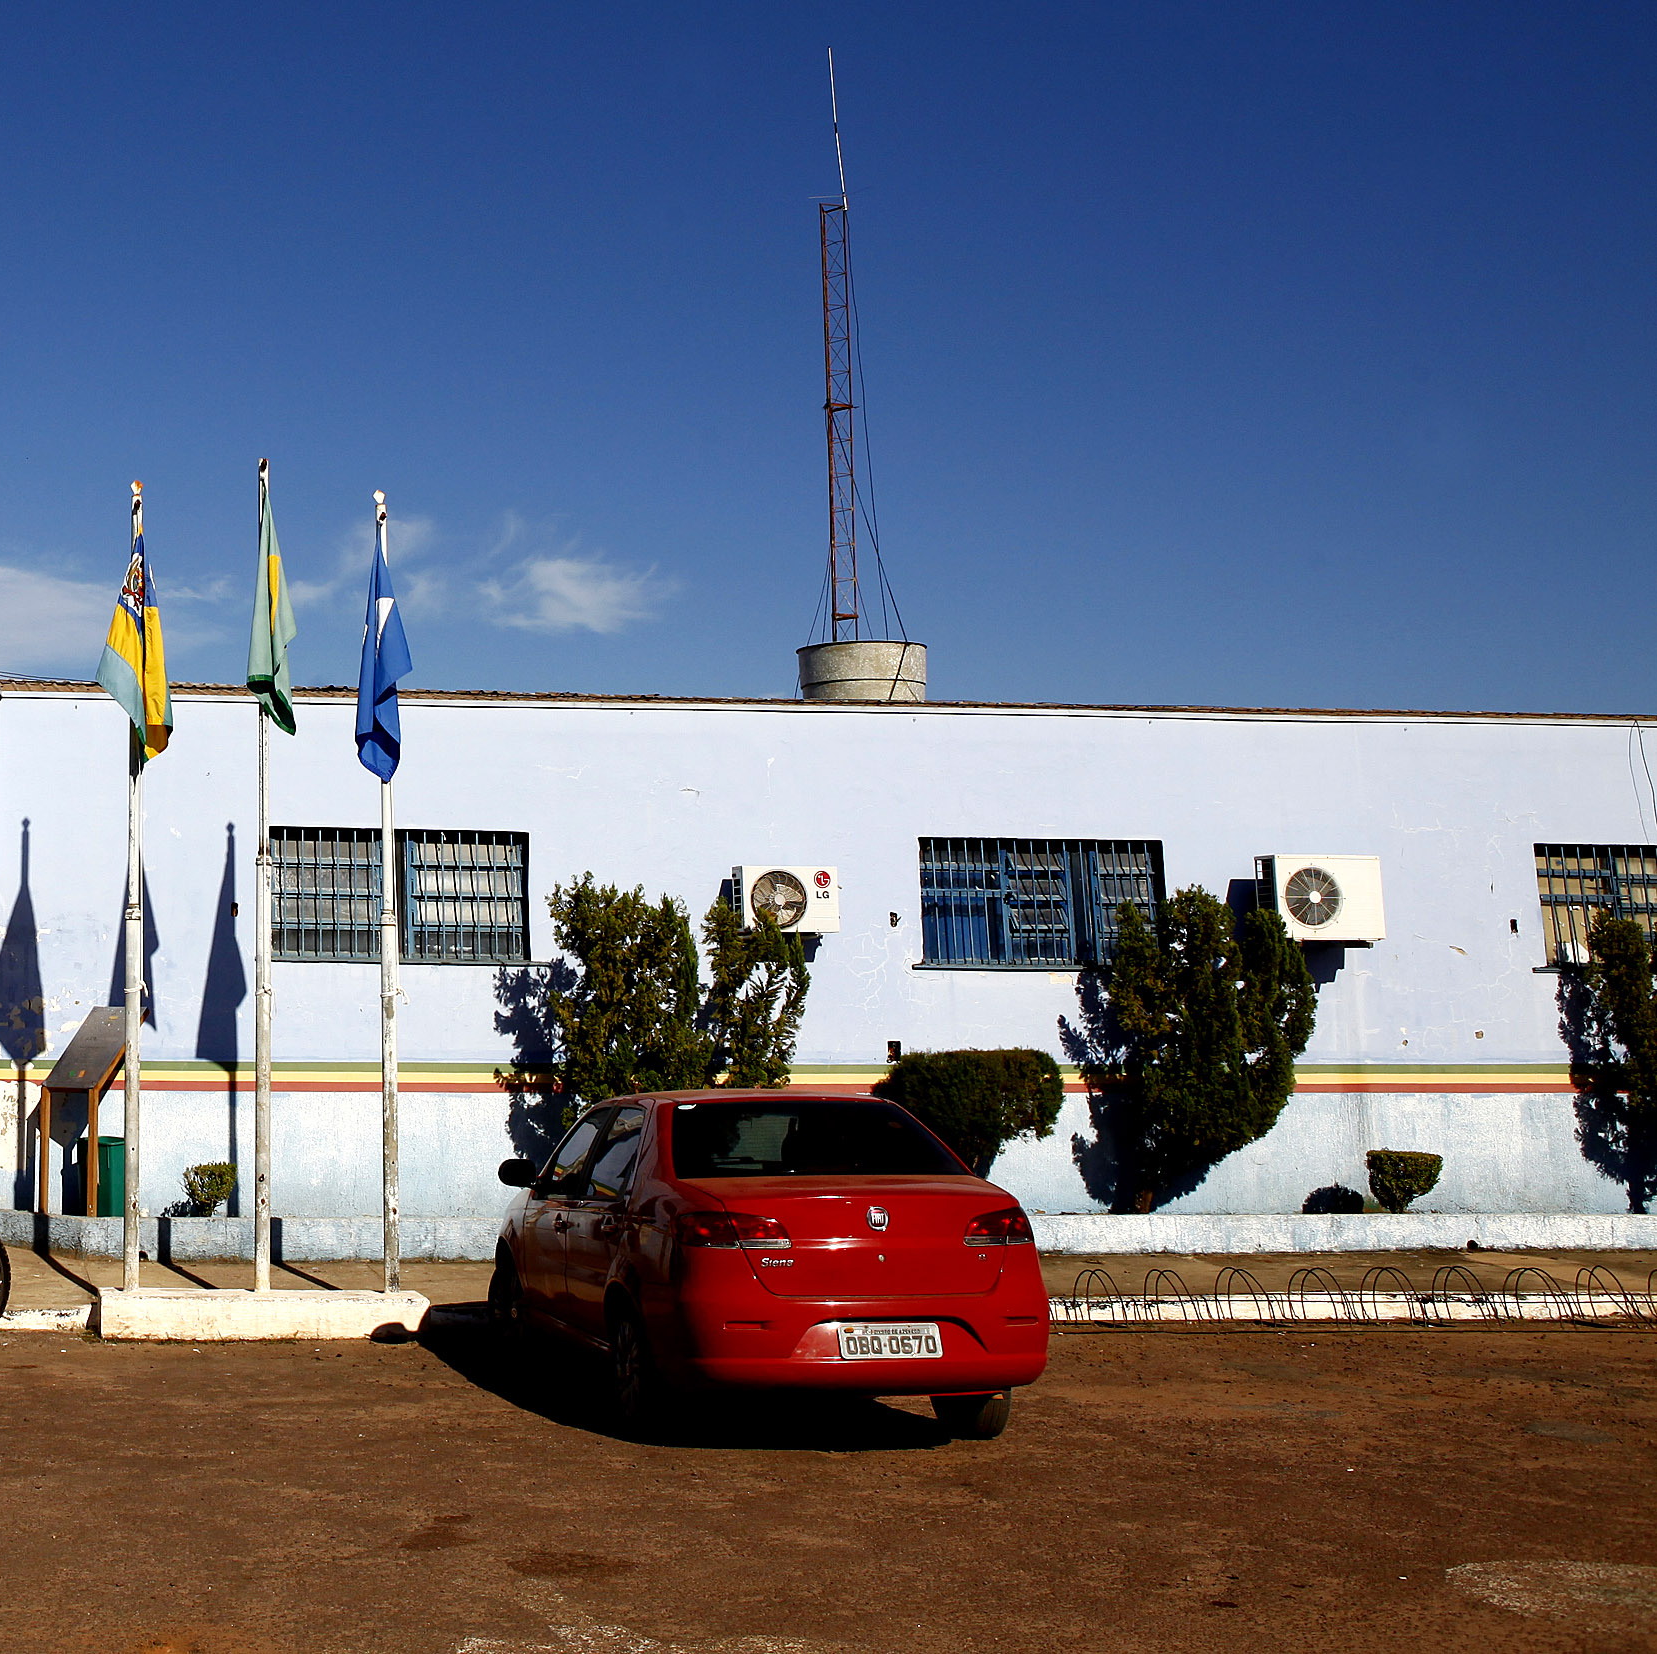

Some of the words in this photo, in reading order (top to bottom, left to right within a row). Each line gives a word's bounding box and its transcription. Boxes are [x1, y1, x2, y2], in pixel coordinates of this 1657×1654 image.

[816, 890, 830, 899] LG
[871, 1213, 885, 1224] FIAT
[760, 1257, 794, 1268] Siena
